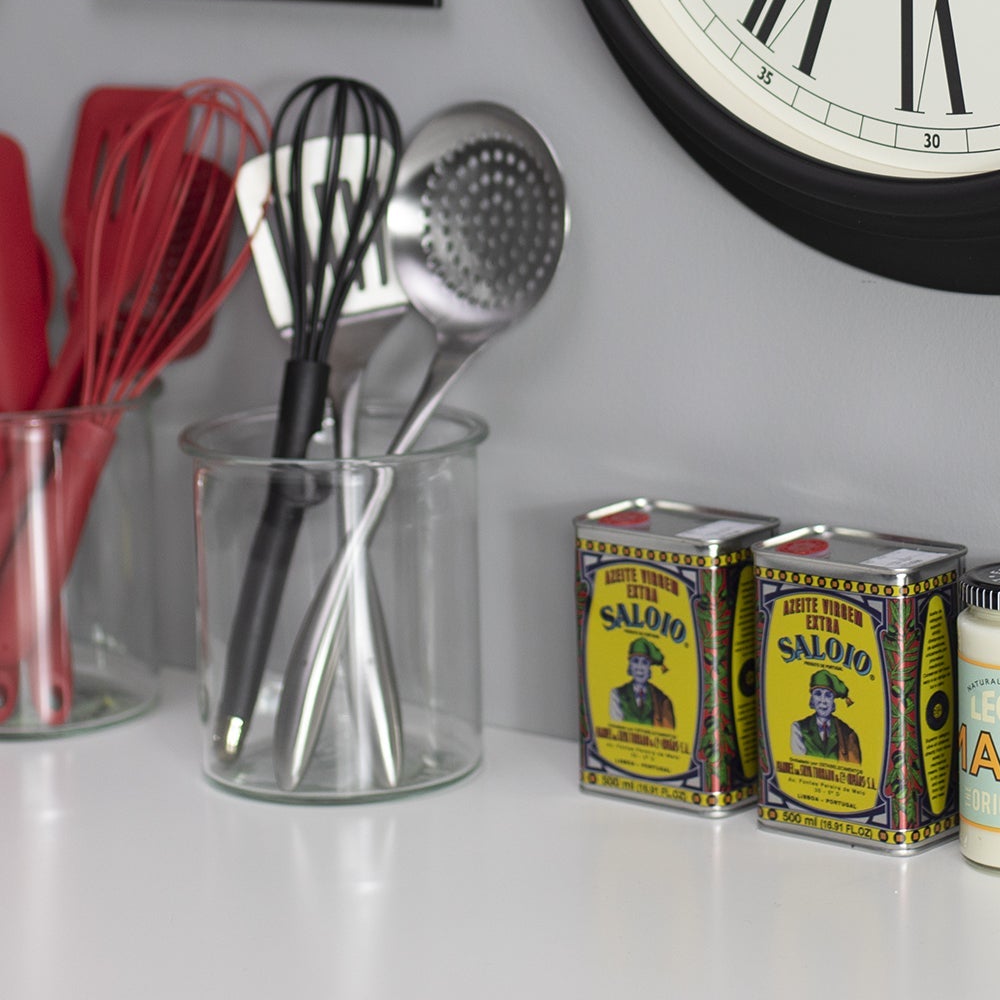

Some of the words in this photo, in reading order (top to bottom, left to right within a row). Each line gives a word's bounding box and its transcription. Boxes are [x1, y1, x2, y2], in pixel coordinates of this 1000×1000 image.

[757, 66, 775, 85] 35
[924, 133, 941, 149] 30
[783, 597, 818, 616] AZEITE
[600, 603, 686, 644] SALOIO
[806, 614, 840, 635] EXTRA
[777, 634, 872, 676] SALOIO
[825, 798, 857, 809] PORTUGAL
[783, 811, 801, 823] 500
[805, 817, 818, 826] ml
